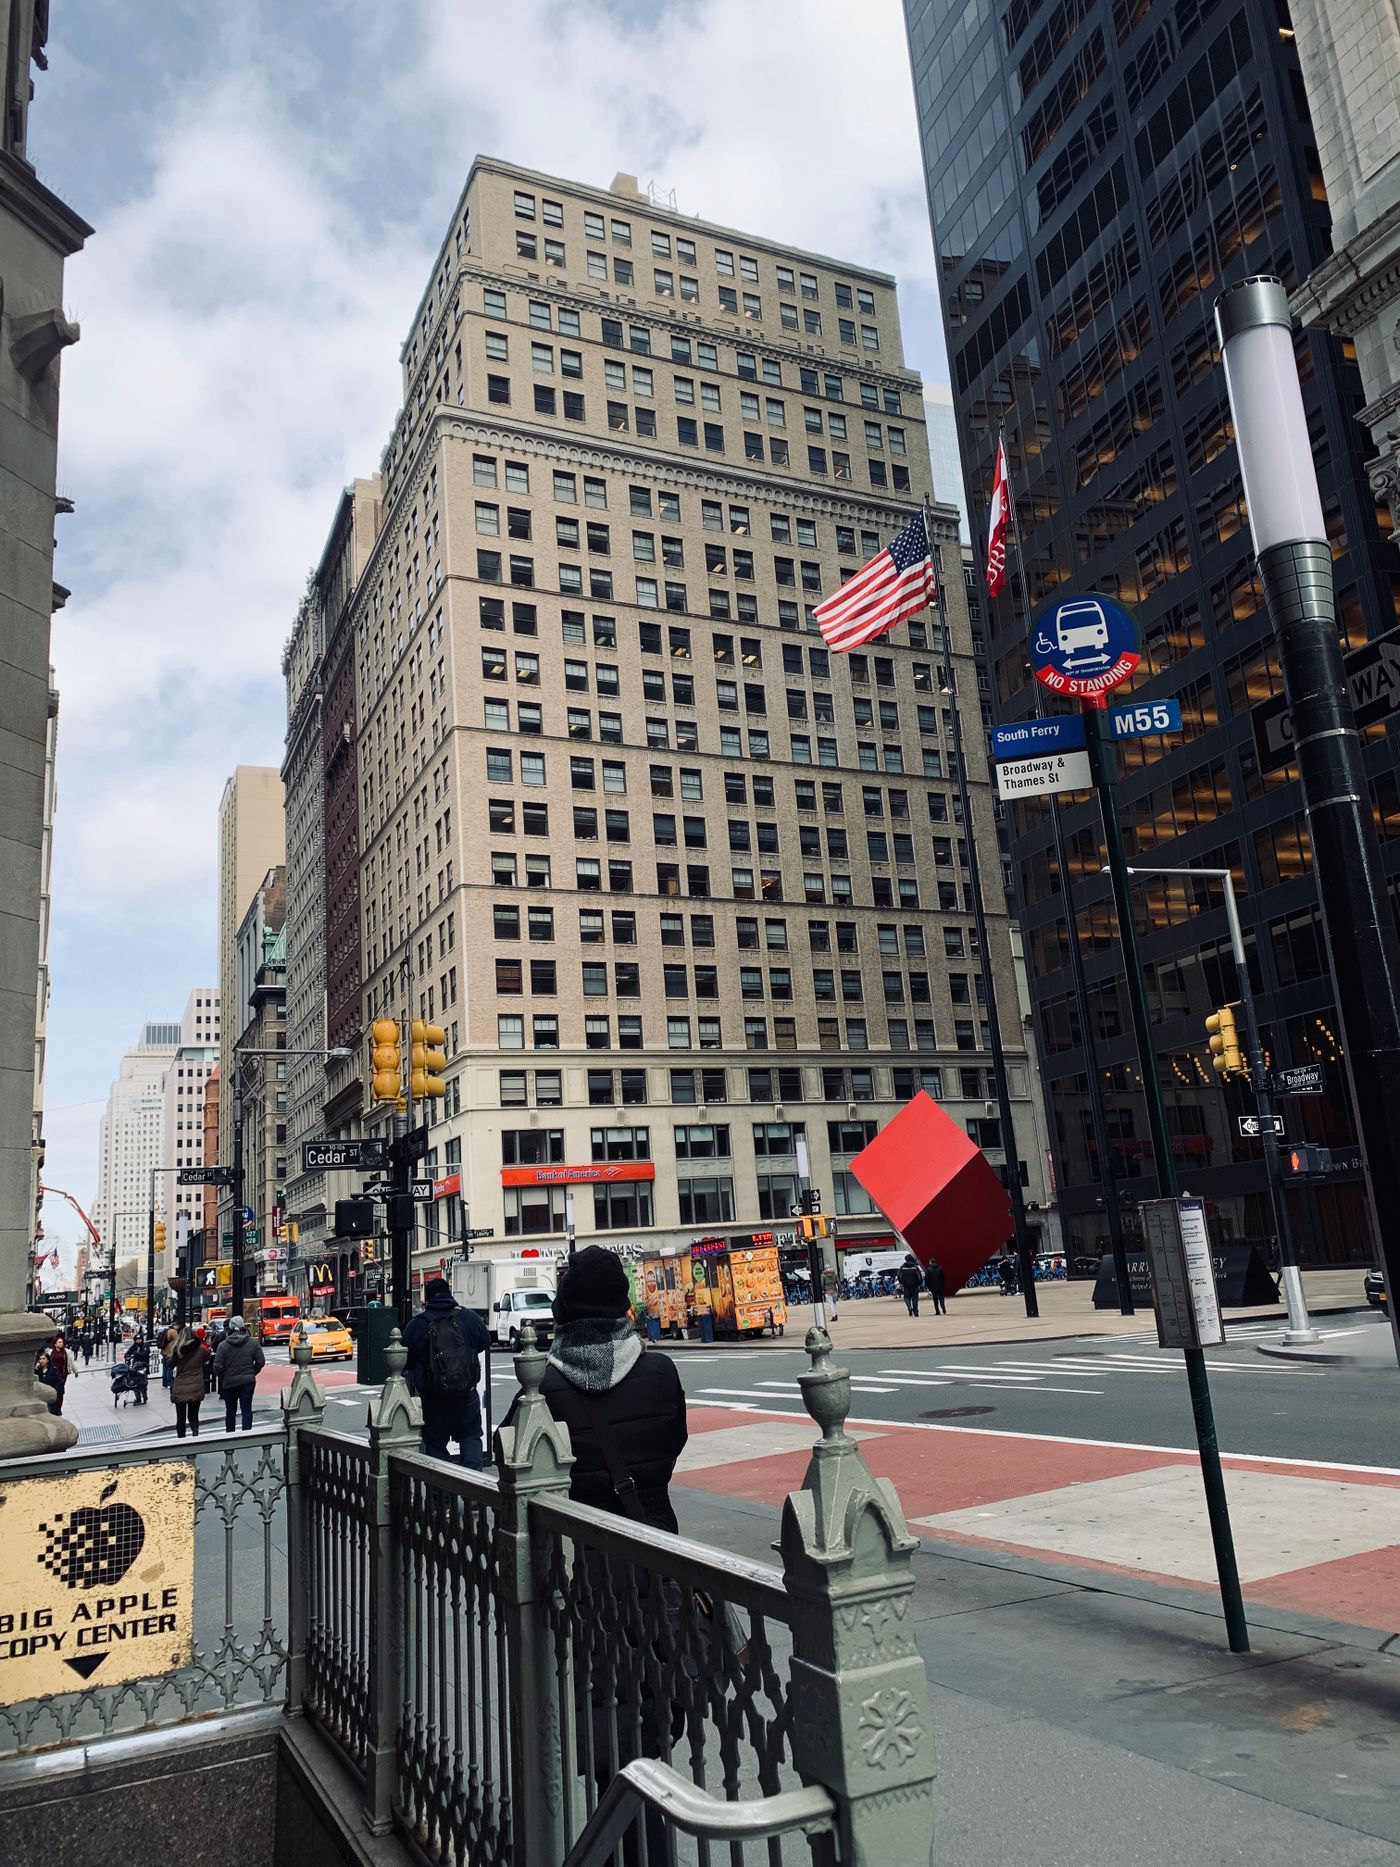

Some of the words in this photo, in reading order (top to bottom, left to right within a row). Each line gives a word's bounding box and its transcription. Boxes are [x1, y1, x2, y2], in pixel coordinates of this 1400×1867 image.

[1045, 672, 1064, 689] NO
[1068, 659, 1133, 693] STANDING
[1114, 705, 1170, 735] M55
[997, 729, 1029, 743] South
[1031, 725, 1060, 738] Ferry
[1003, 760, 1053, 776] Broadway
[1057, 758, 1065, 768] &
[1004, 776, 1045, 790] Thames
[1048, 772, 1060, 783] St
[1286, 1071, 1319, 1086] Broadway
[308, 1150, 346, 1165] Cedar
[350, 1148, 358, 1157] ST
[183, 1172, 205, 1181] Cedar
[537, 1170, 558, 1180] Bank
[558, 1170, 568, 1179] of
[569, 1169, 602, 1178] America
[0, 1608, 53, 1634] BIG
[71, 1588, 178, 1623] APPLE
[76, 1614, 177, 1647] CENTER
